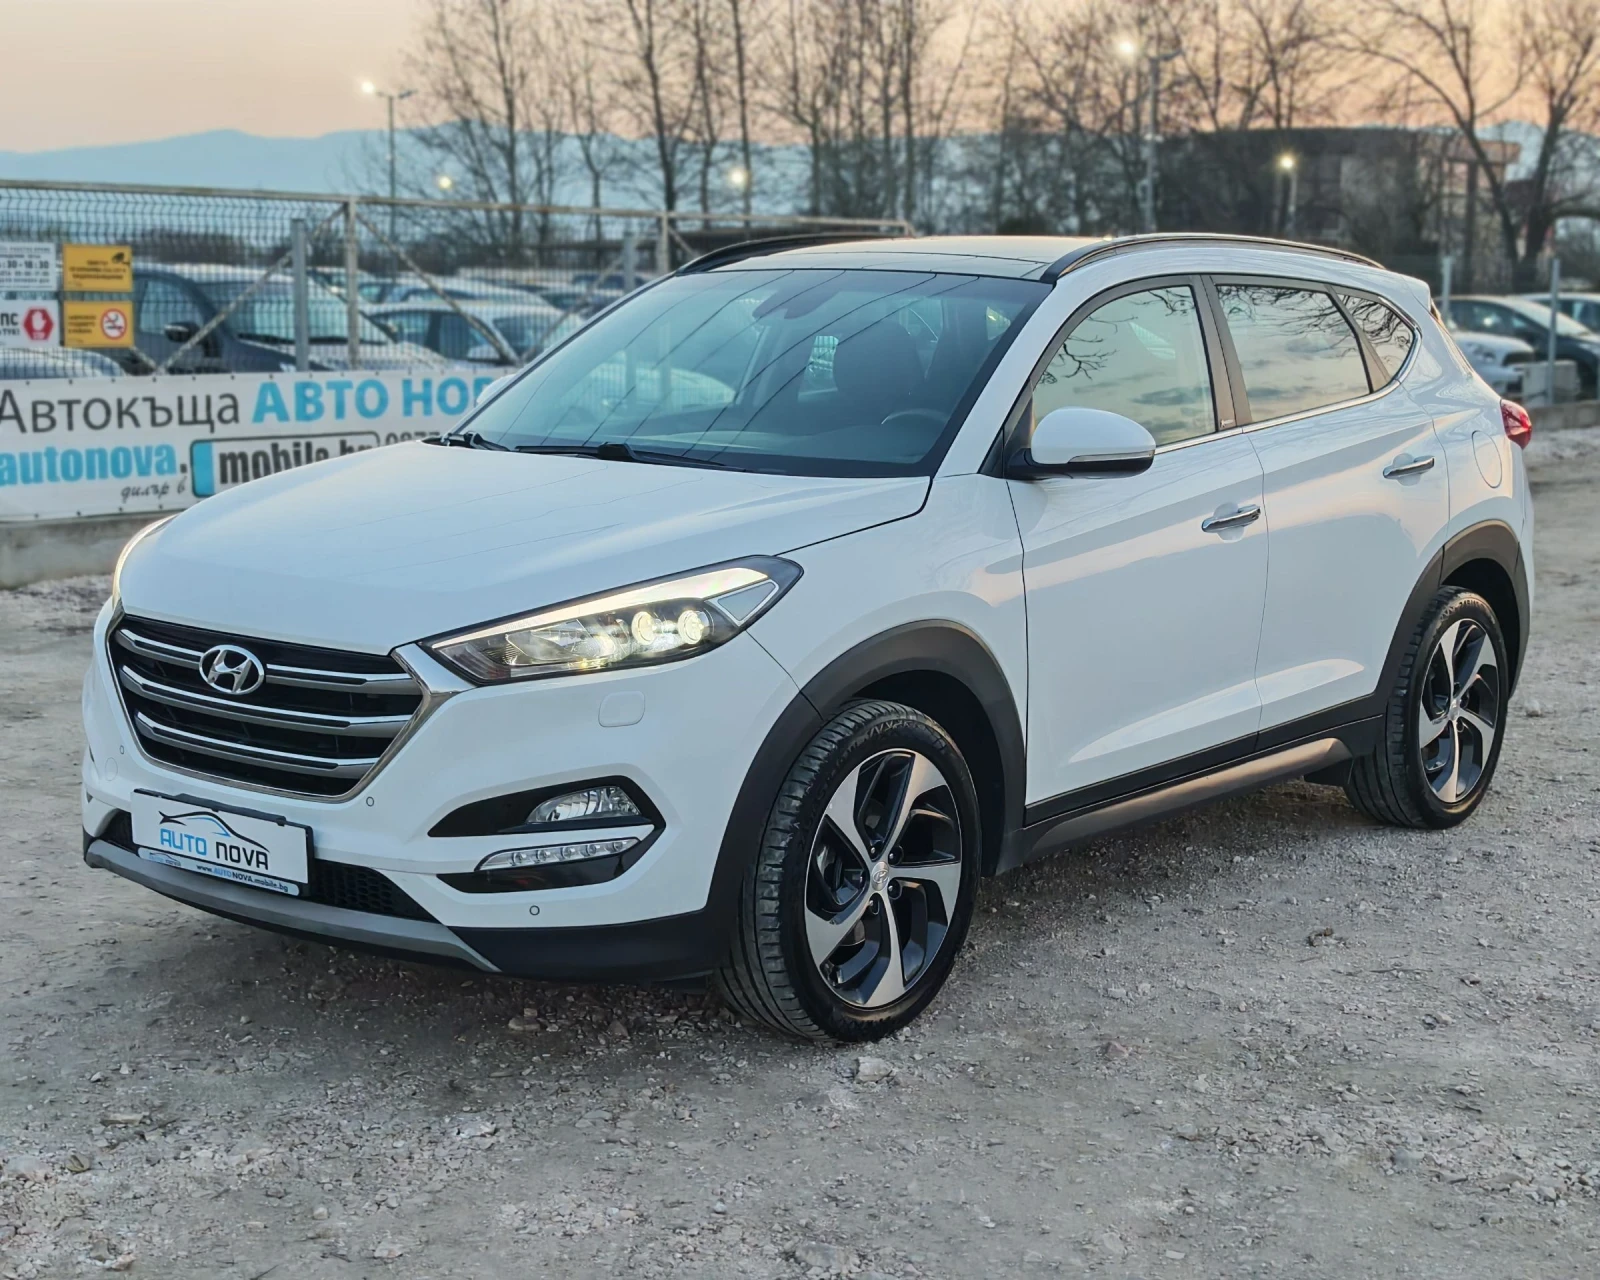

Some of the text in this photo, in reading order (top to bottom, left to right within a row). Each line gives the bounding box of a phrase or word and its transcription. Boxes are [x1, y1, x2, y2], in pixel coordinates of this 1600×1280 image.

[0, 389, 239, 434] Автокъща
[252, 380, 389, 423] АВТО
[160, 828, 269, 870] AUTO NOVA
